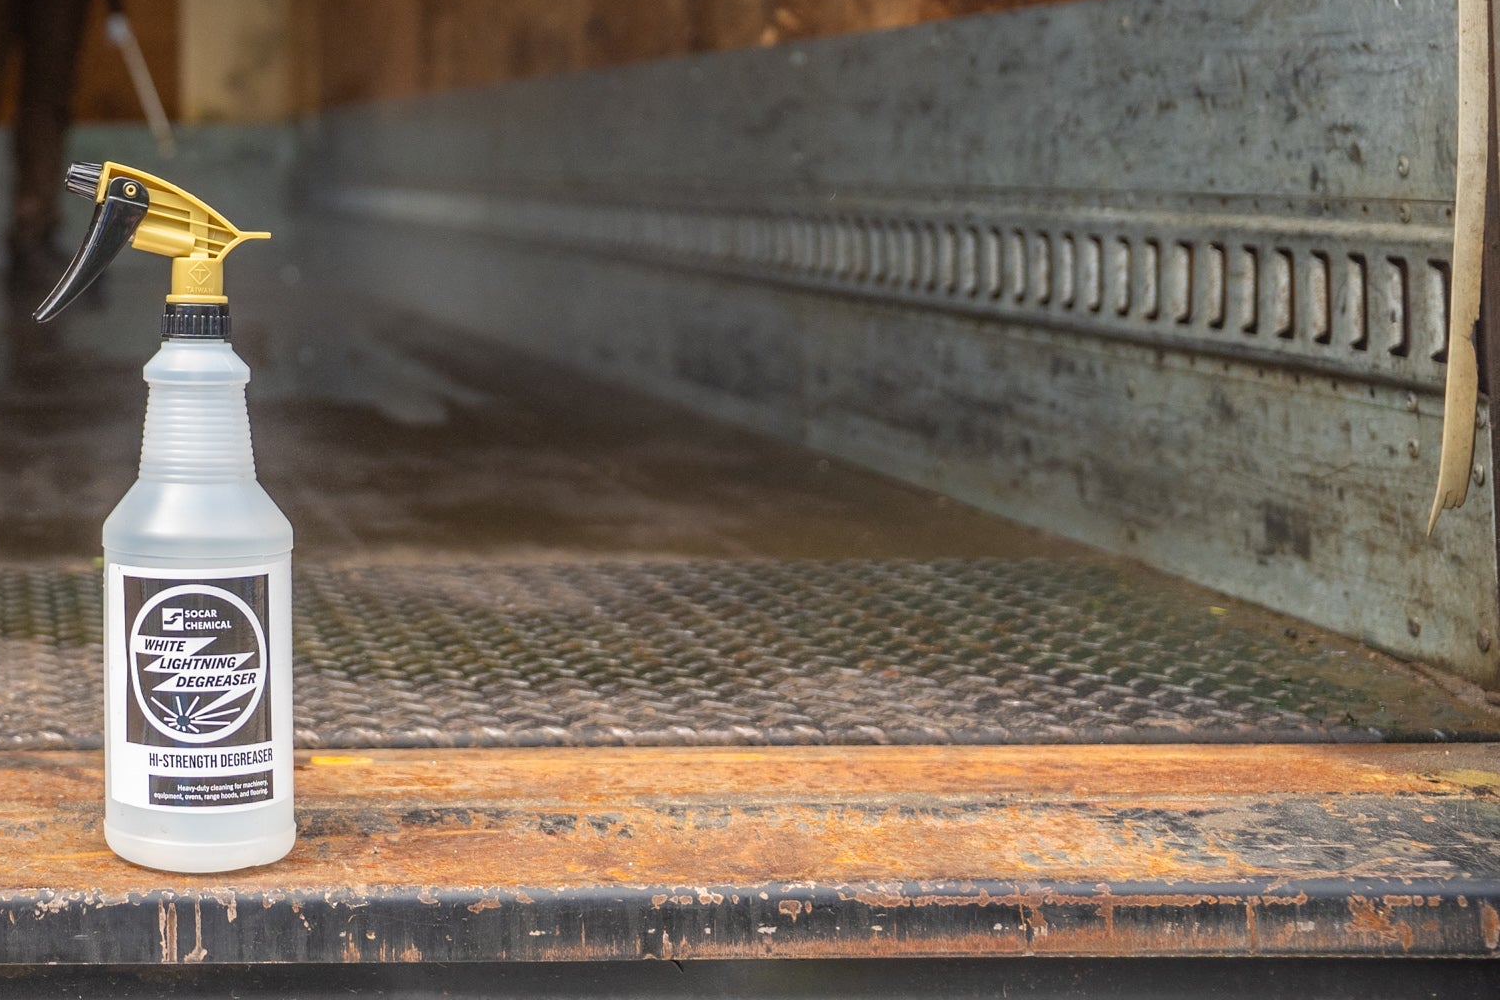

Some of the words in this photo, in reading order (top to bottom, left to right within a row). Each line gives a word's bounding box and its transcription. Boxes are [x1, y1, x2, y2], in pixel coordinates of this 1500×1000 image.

[185, 285, 214, 294] TAIWAN
[184, 609, 218, 618] SOCAR
[184, 620, 232, 630] CHEMICAL
[144, 638, 186, 652] WHITE
[159, 656, 237, 670] LIGHTNING
[175, 672, 257, 688] DEGREASER
[149, 752, 218, 769] HI-STRENGTH
[221, 747, 273, 768] DEGREASER
[177, 784, 209, 793] Heavy-duty
[153, 791, 184, 800] equipment,
[220, 791, 239, 799] hoods,
[239, 790, 249, 798] and
